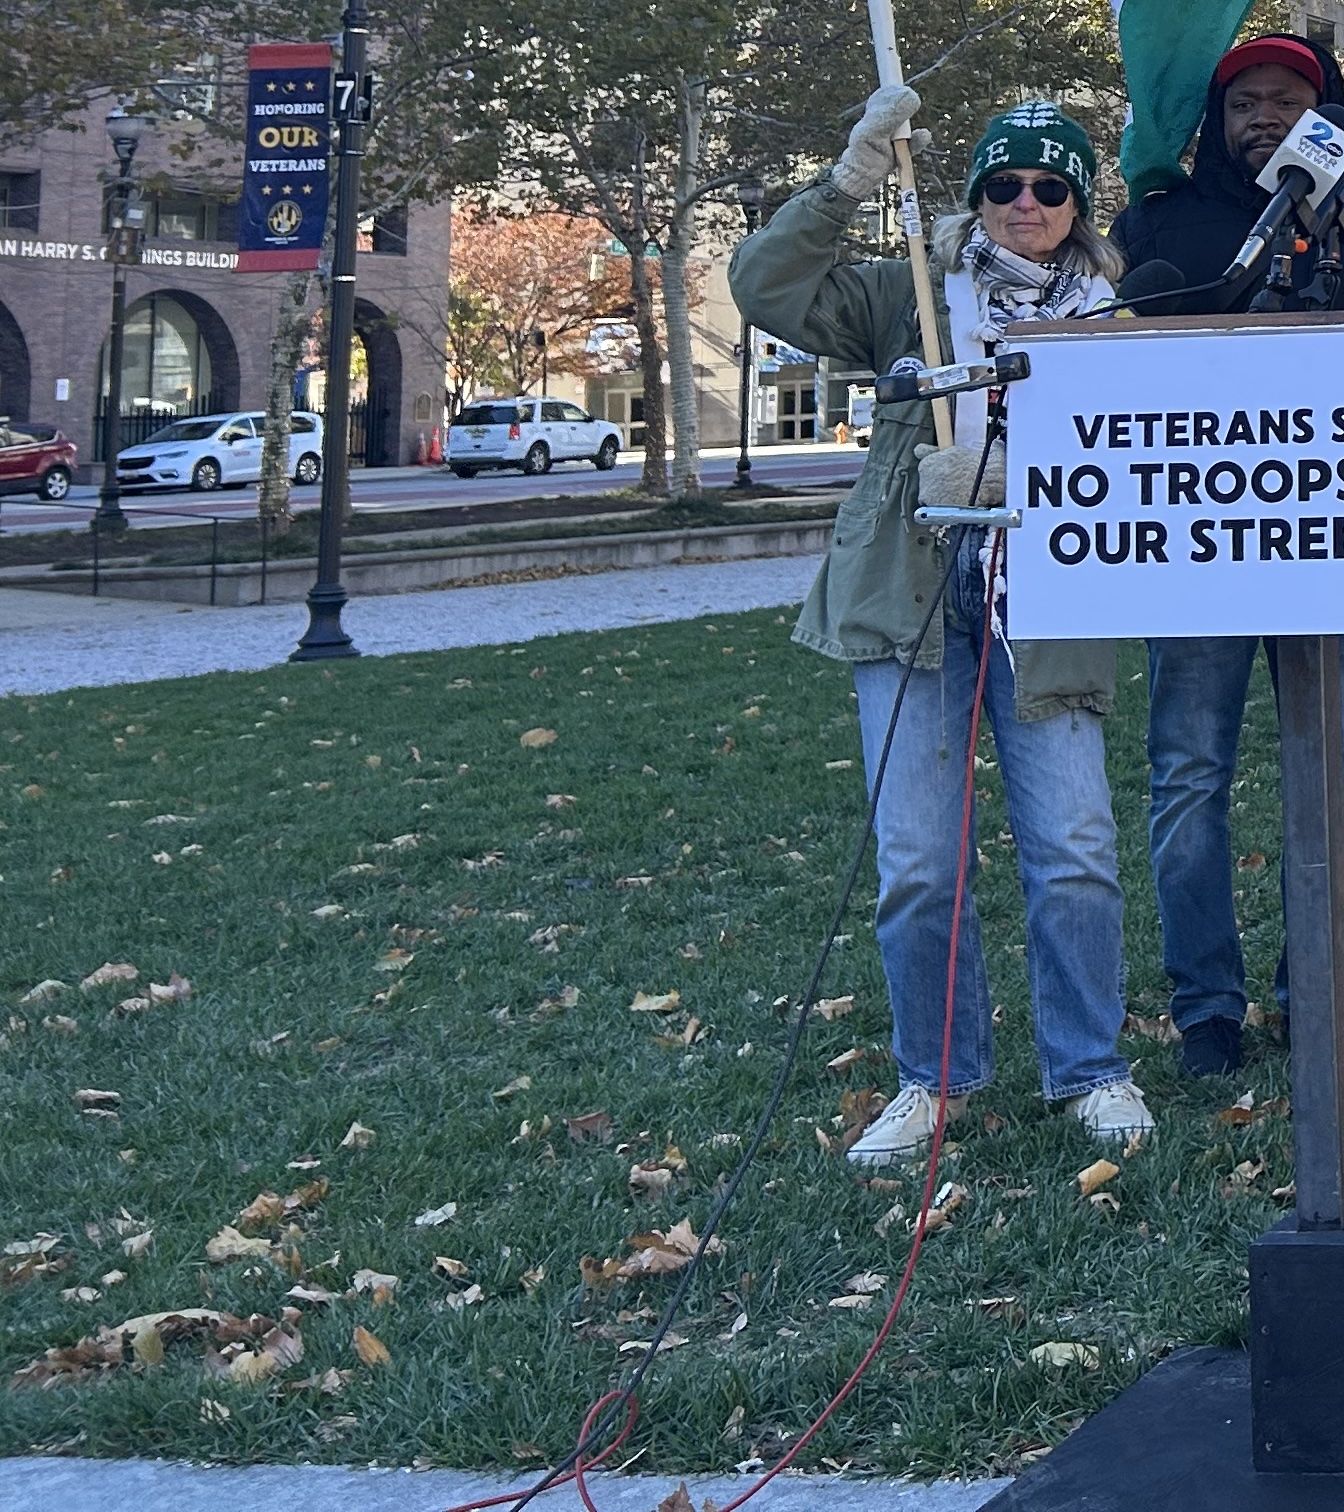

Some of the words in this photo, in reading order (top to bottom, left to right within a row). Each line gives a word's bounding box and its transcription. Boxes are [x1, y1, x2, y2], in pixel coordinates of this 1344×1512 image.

[254, 102, 325, 116] HONORING
[335, 80, 355, 111] 7
[259, 126, 319, 149] OUR
[1302, 121, 1334, 151] 2
[249, 158, 326, 173] VETERANS
[1296, 144, 1331, 170] NEWS
[1299, 136, 1338, 169] WMAR
[21, 240, 80, 260] HARRY
[82, 245, 96, 261] S.
[1073, 408, 1314, 449] VETERANS
[1027, 464, 1110, 509] NO
[1048, 520, 1170, 566] OUR
